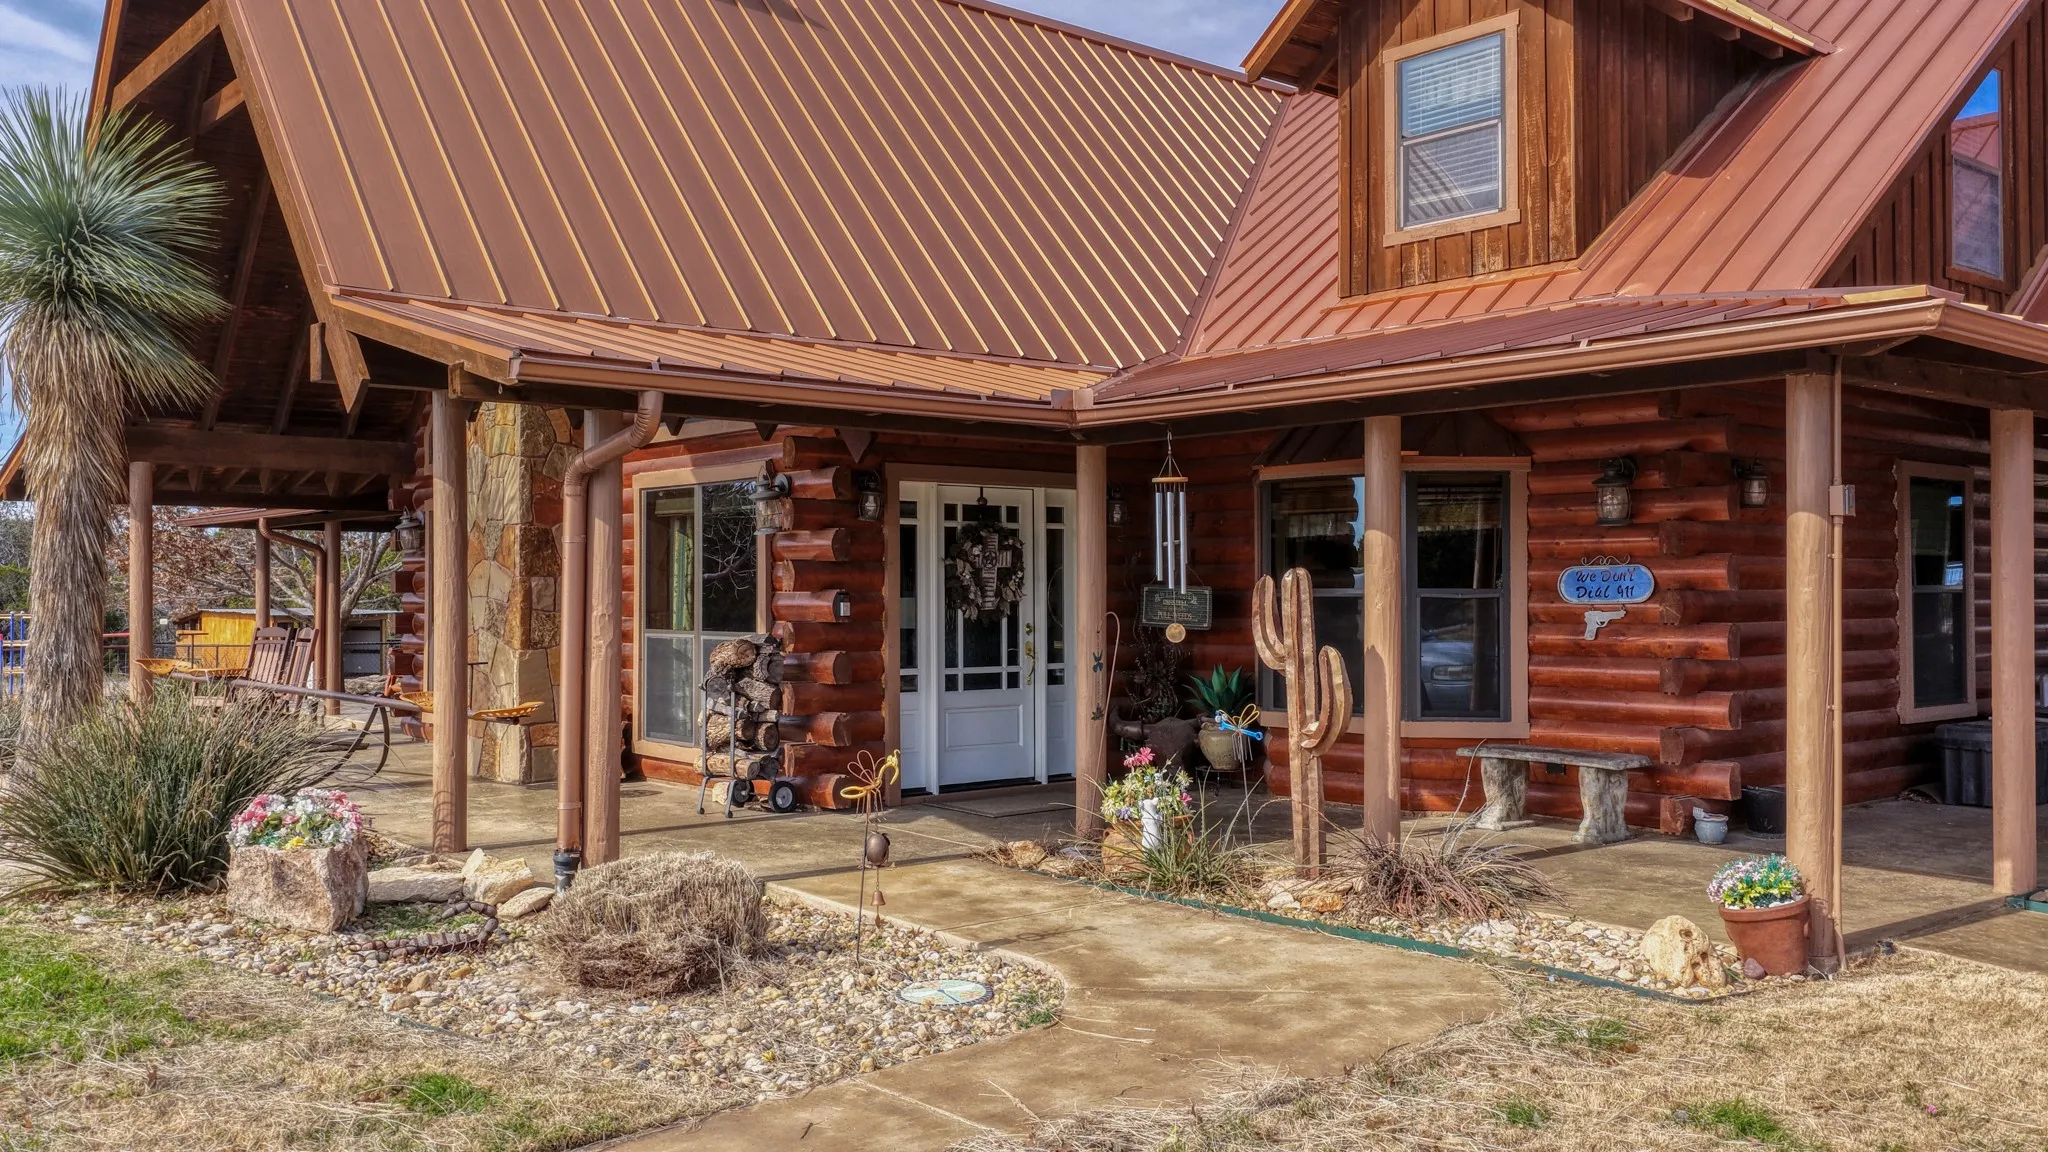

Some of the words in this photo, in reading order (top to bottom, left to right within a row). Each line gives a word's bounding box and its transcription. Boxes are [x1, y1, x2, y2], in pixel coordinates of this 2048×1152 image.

[1575, 570, 1597, 583] We
[1575, 585, 1610, 598] Dial
[1617, 585, 1635, 598] 911
